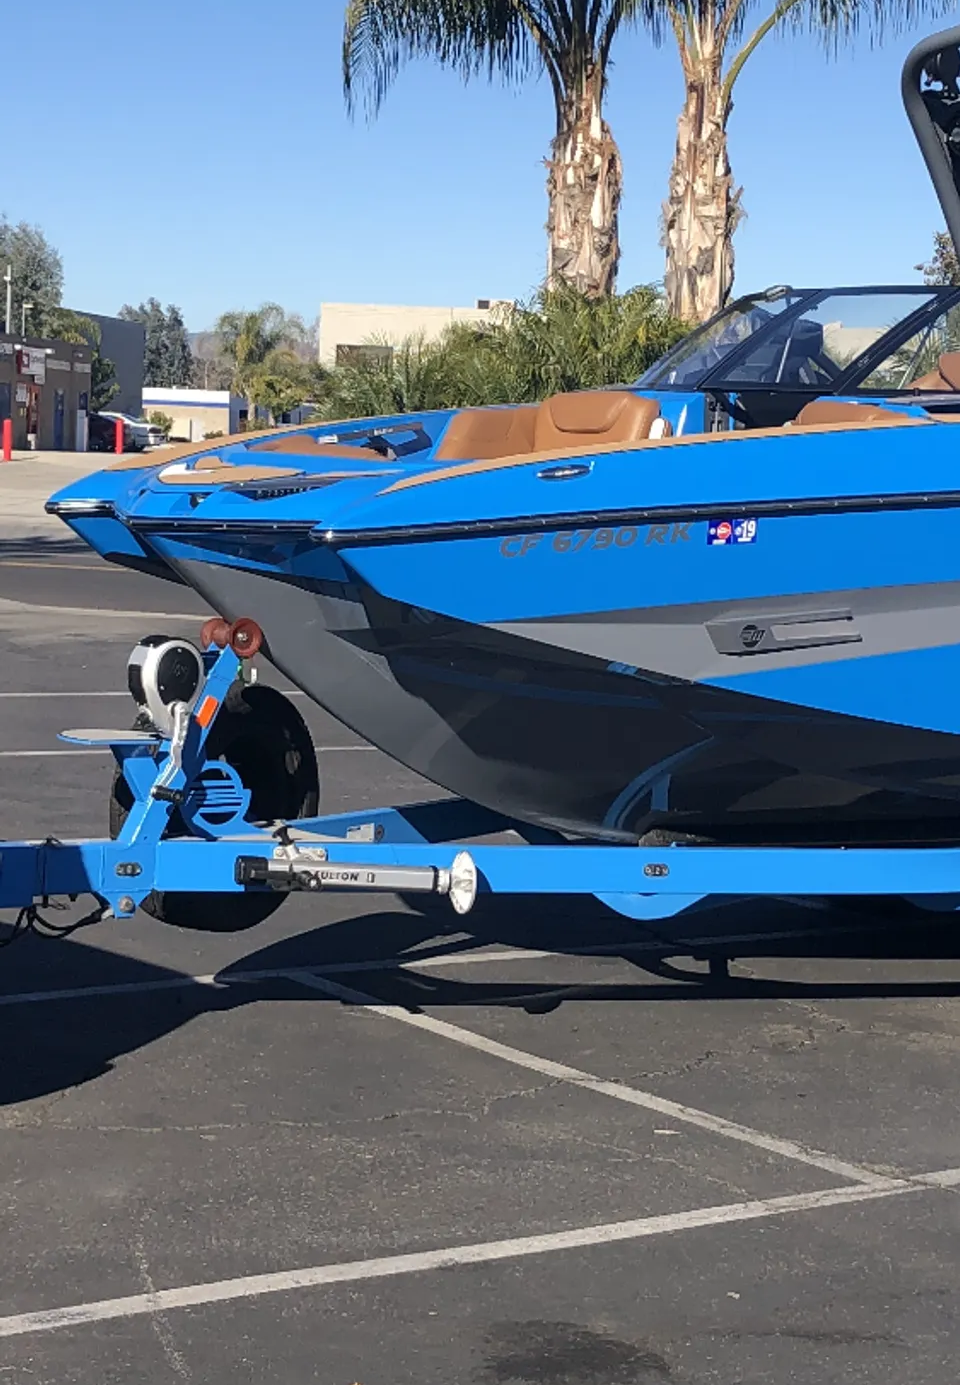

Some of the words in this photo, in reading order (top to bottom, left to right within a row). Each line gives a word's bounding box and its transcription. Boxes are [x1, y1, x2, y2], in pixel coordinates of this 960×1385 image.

[500, 534, 544, 558] CF
[553, 525, 638, 553] 6790
[646, 522, 692, 545] RK
[741, 520, 757, 539] 19
